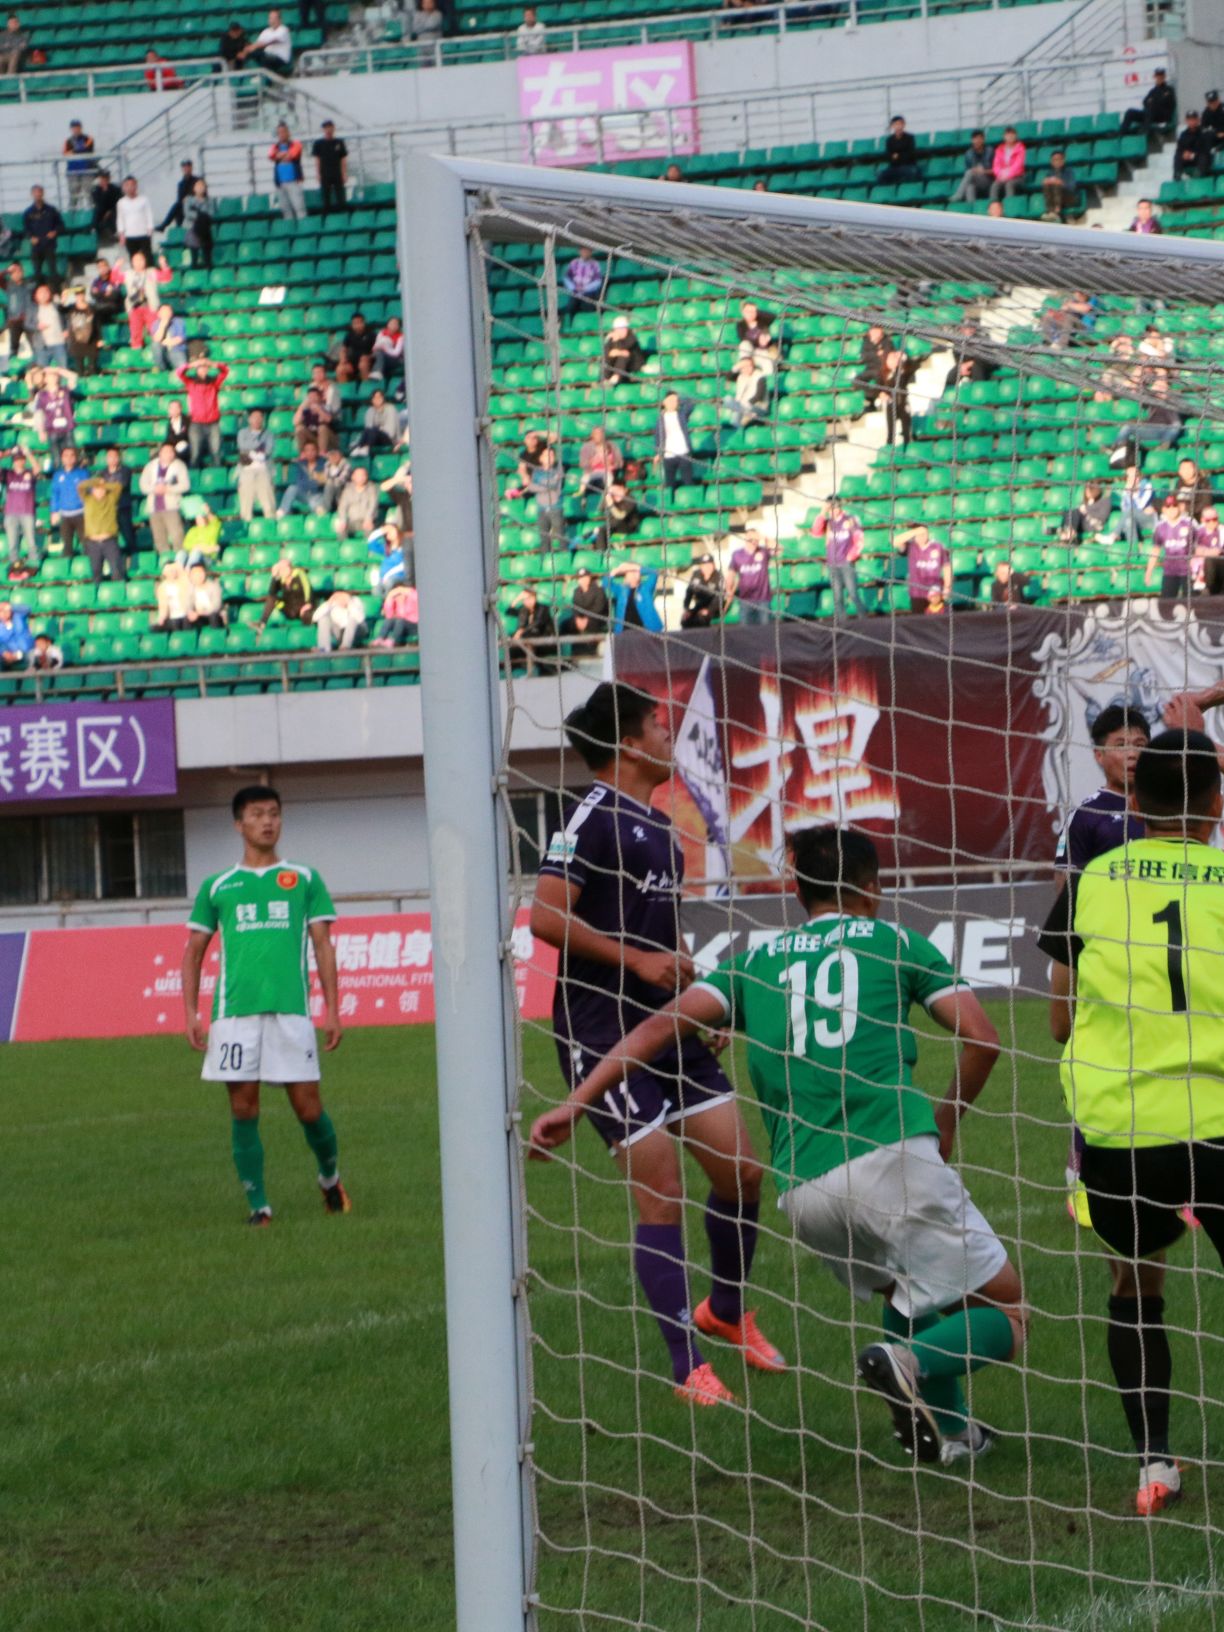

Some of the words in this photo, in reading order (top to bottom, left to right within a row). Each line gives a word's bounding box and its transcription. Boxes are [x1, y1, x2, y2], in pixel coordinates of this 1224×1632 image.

[729, 691, 900, 877] 捏
[779, 950, 859, 1057] 19
[1152, 900, 1188, 1012] 1
[219, 1043, 243, 1070] 20
